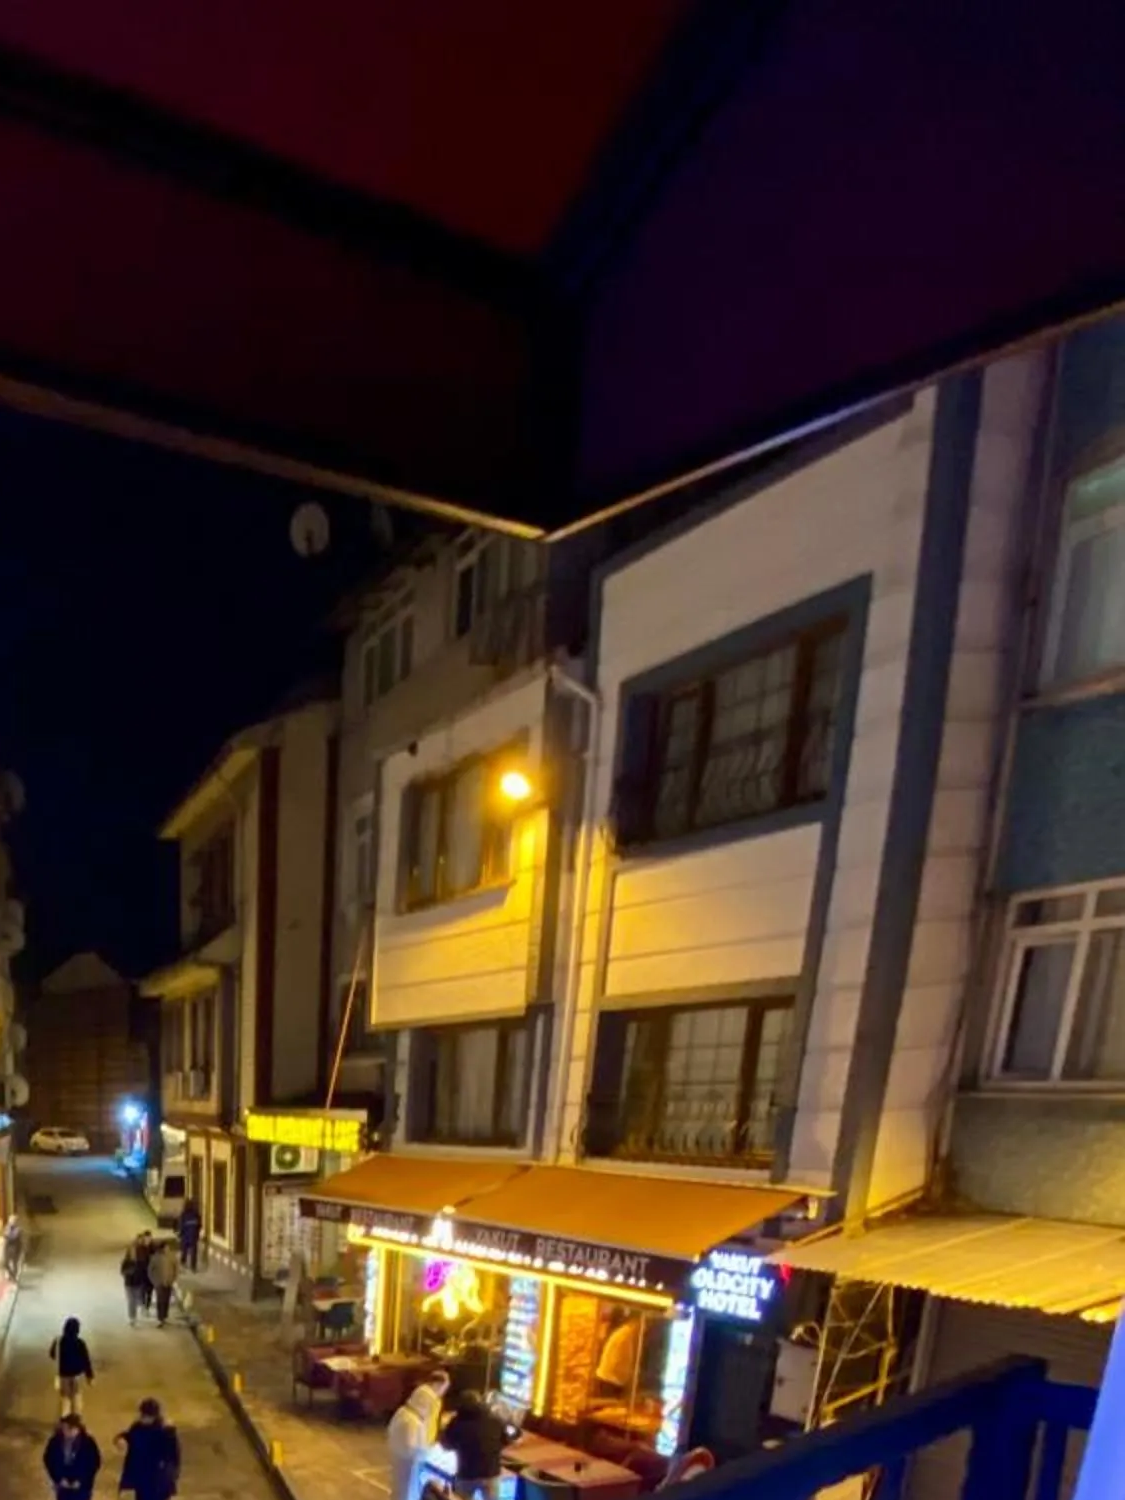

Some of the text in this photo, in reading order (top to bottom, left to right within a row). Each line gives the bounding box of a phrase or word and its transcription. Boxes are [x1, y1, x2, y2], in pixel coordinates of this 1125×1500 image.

[476, 1228, 521, 1251] YAKUT
[535, 1237, 651, 1278] RESTAURANT
[697, 1288, 762, 1320] HOTEL
